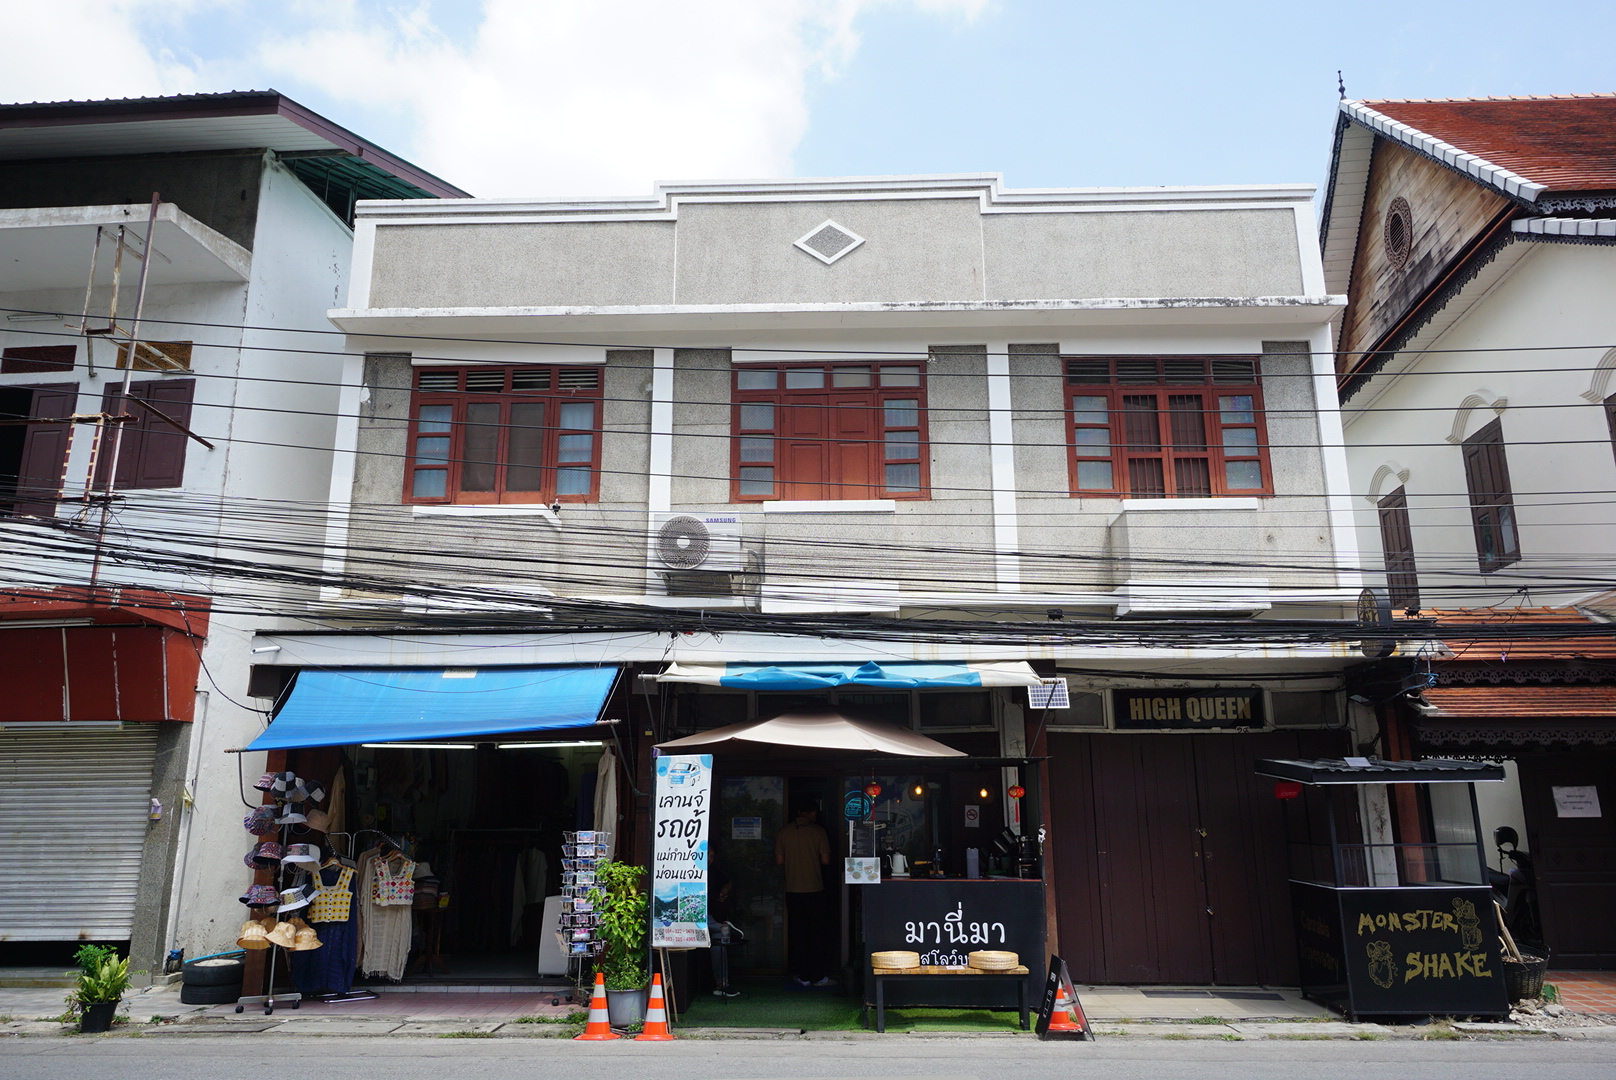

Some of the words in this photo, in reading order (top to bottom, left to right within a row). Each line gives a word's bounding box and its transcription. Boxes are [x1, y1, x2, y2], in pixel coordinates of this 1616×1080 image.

[1130, 698, 1180, 720] HIGH
[1186, 697, 1251, 722] QUEEN
[659, 789, 706, 808] เลานจ์
[658, 809, 706, 848] รถตู้
[657, 848, 704, 860] แม่กำปอง
[656, 864, 703, 880] ม่อนแจ่ม
[904, 901, 1006, 944] มานี่มา
[1357, 910, 1459, 936] MONSTER
[920, 949, 969, 966] สโลว์บ
[1404, 951, 1493, 984] SHAKE
